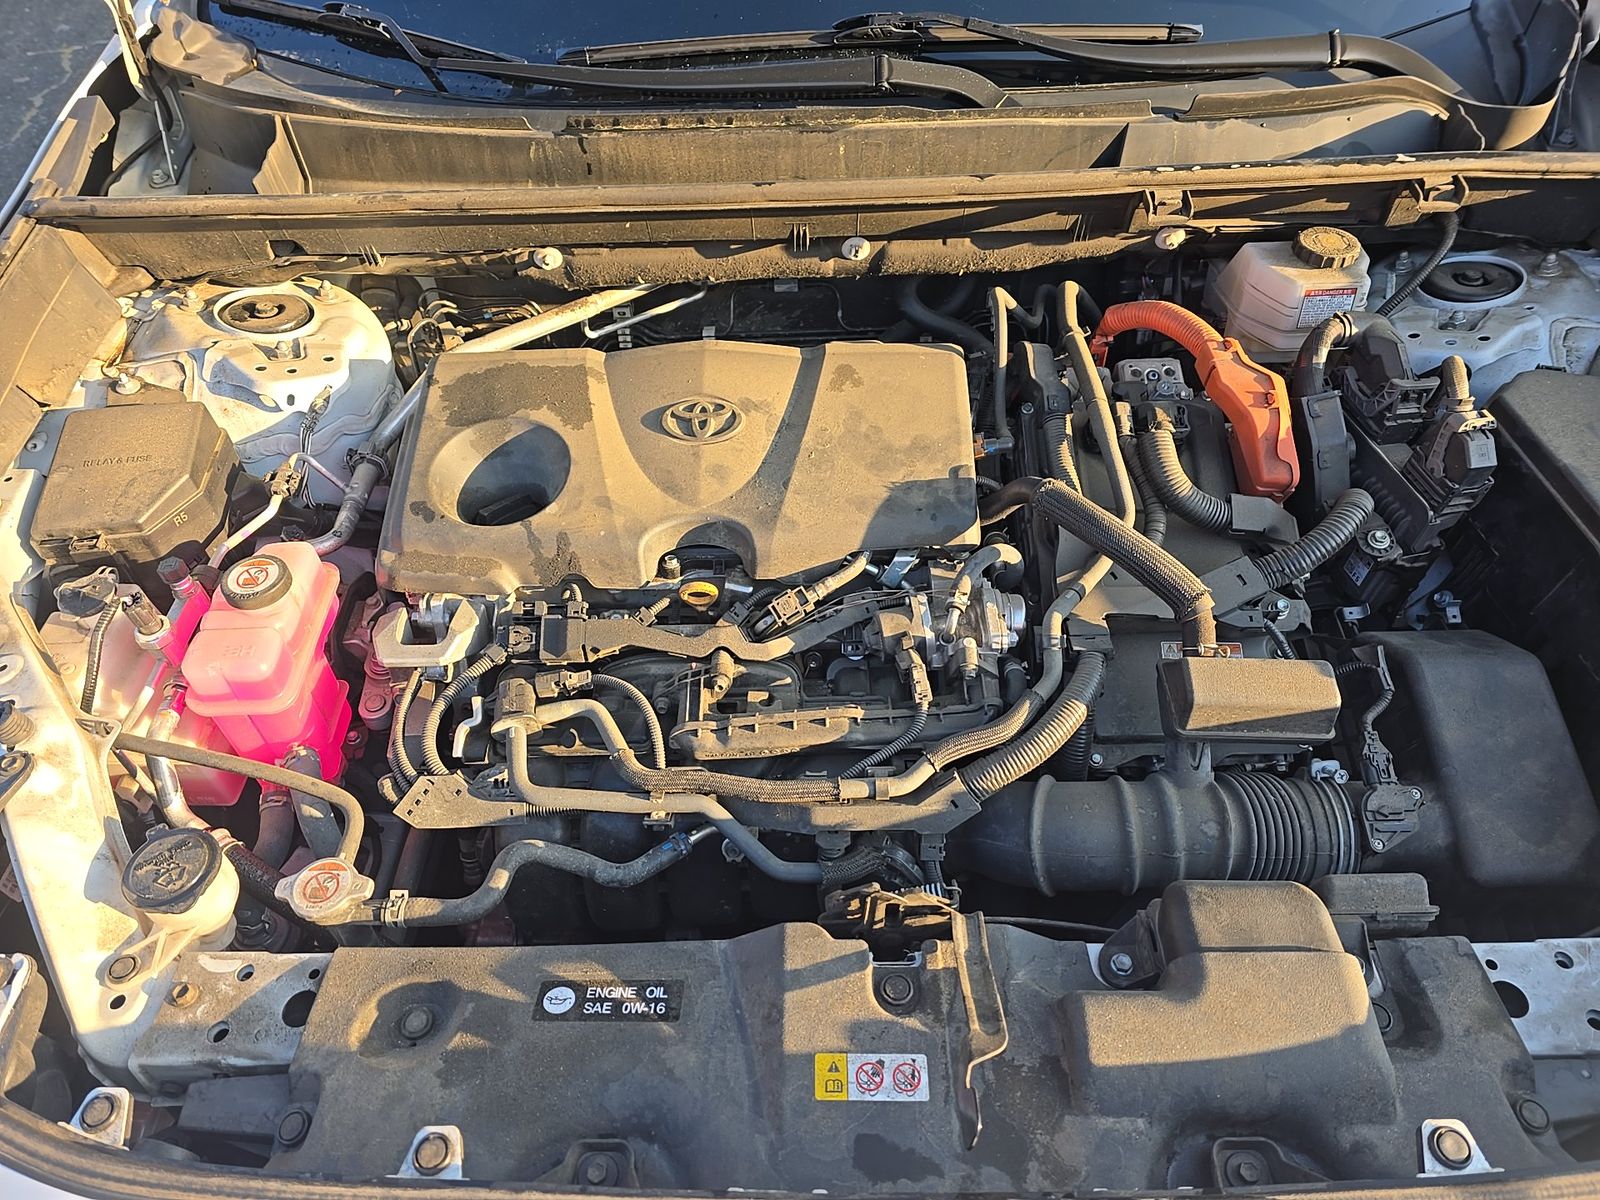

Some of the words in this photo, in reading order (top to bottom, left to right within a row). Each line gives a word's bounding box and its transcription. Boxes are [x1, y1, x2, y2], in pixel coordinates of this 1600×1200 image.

[586, 986, 637, 999] ENGINE
[645, 986, 668, 999] OIL
[583, 1002, 612, 1014] SAE
[622, 1002, 666, 1014] 0W-16
